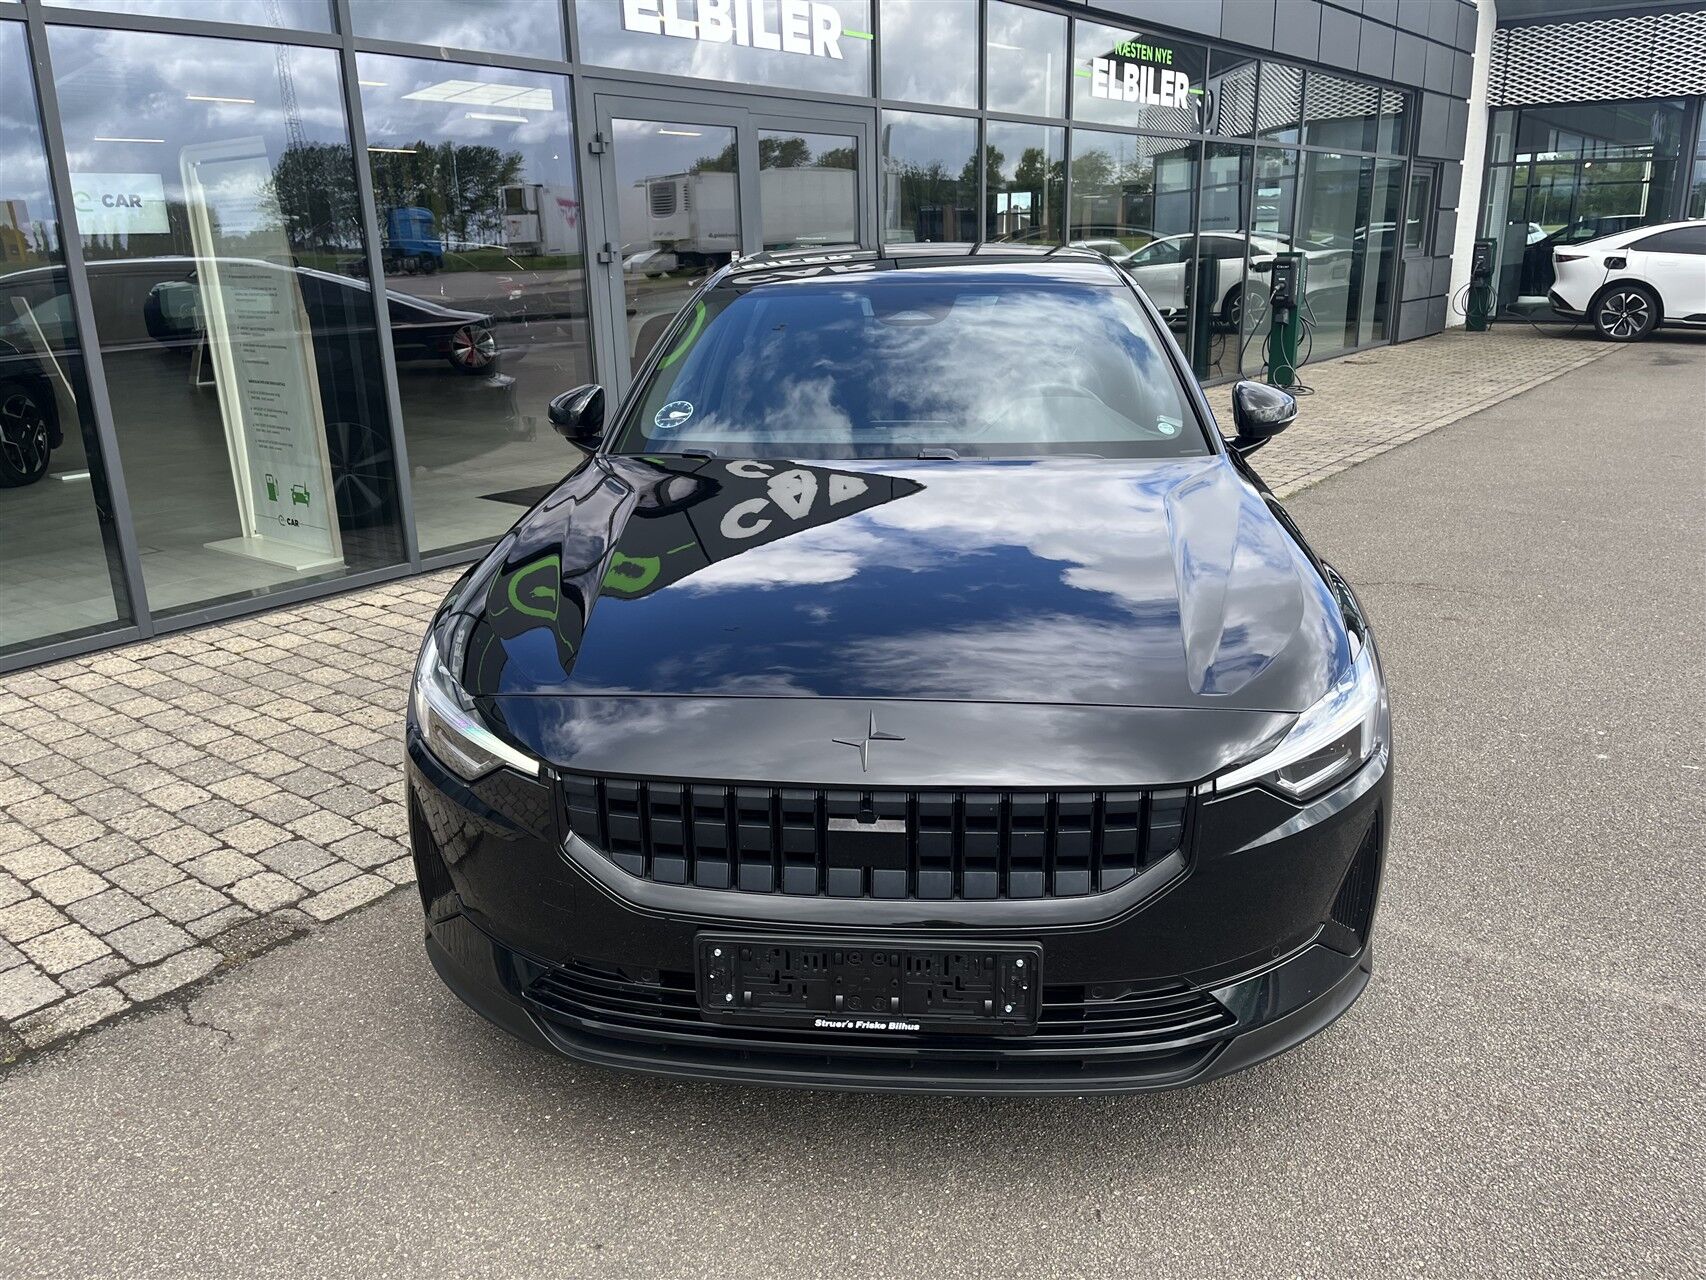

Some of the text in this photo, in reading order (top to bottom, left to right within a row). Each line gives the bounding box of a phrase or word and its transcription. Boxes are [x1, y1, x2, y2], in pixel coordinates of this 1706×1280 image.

[622, 0, 844, 60] ELBILER
[1114, 41, 1173, 65] NÆSTEN NYE
[1091, 56, 1190, 110] ELBILER
[101, 193, 143, 208] CAR
[286, 517, 300, 528] CAR
[855, 1021, 887, 1030] Friske
[888, 1022, 920, 1031] Bilhus
